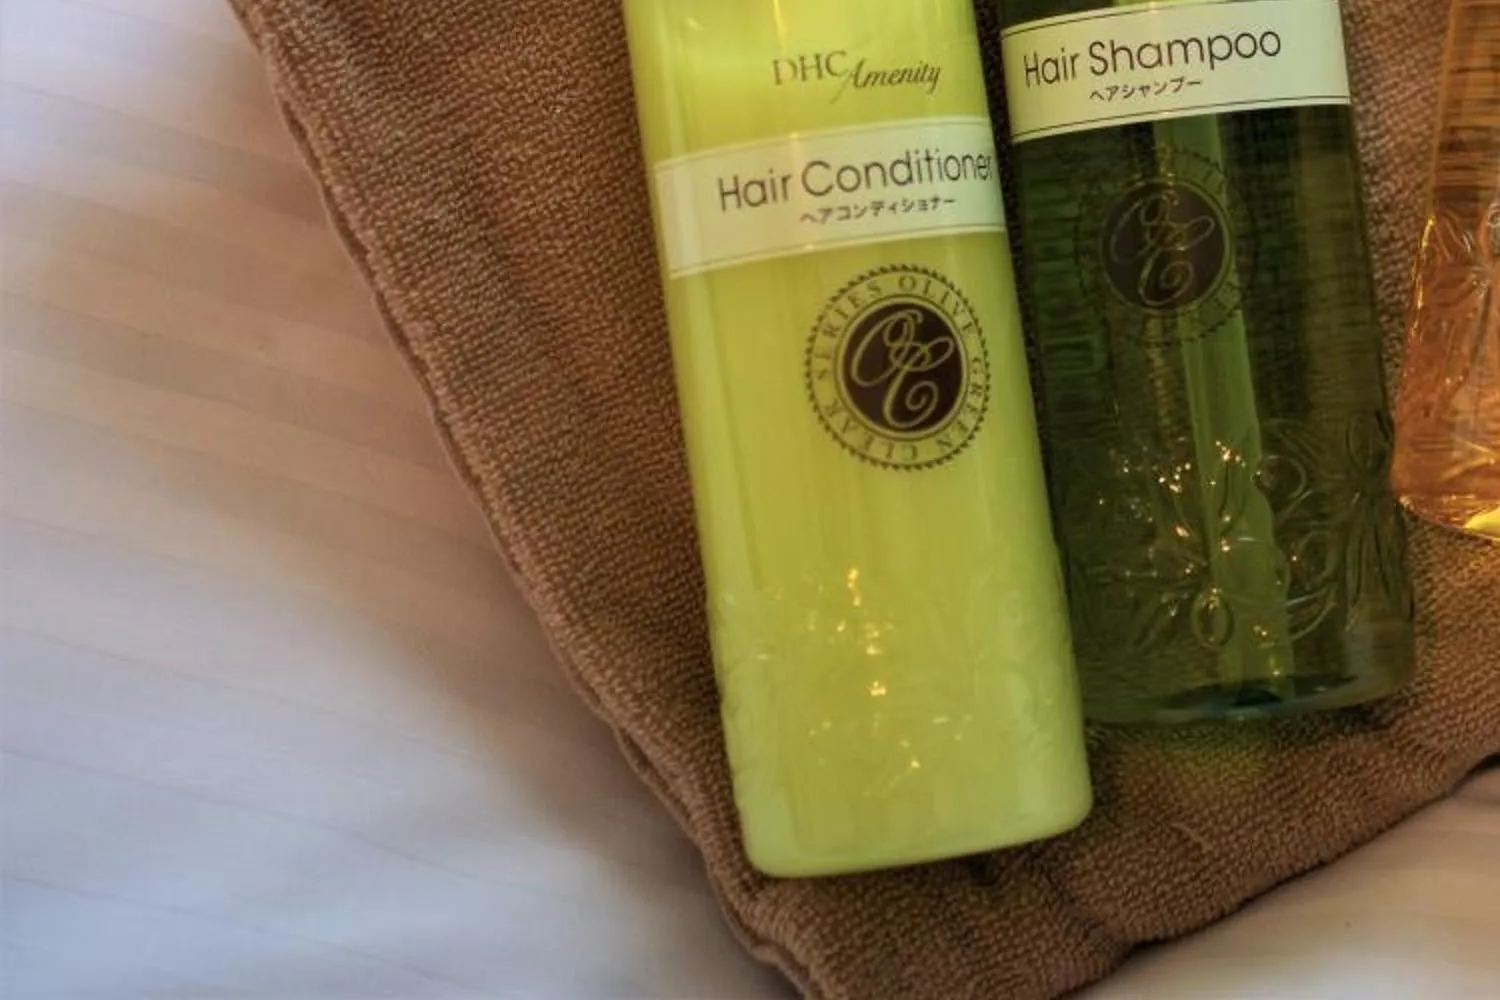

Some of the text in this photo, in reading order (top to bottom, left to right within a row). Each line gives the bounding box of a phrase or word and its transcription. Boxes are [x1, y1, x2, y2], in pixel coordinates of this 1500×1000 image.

[771, 50, 942, 104] DHC Amenity
[1024, 30, 1283, 89] Hair Shampoo
[1089, 76, 1204, 102] ヘアシャンプー
[717, 146, 993, 212] Hair Conditioner
